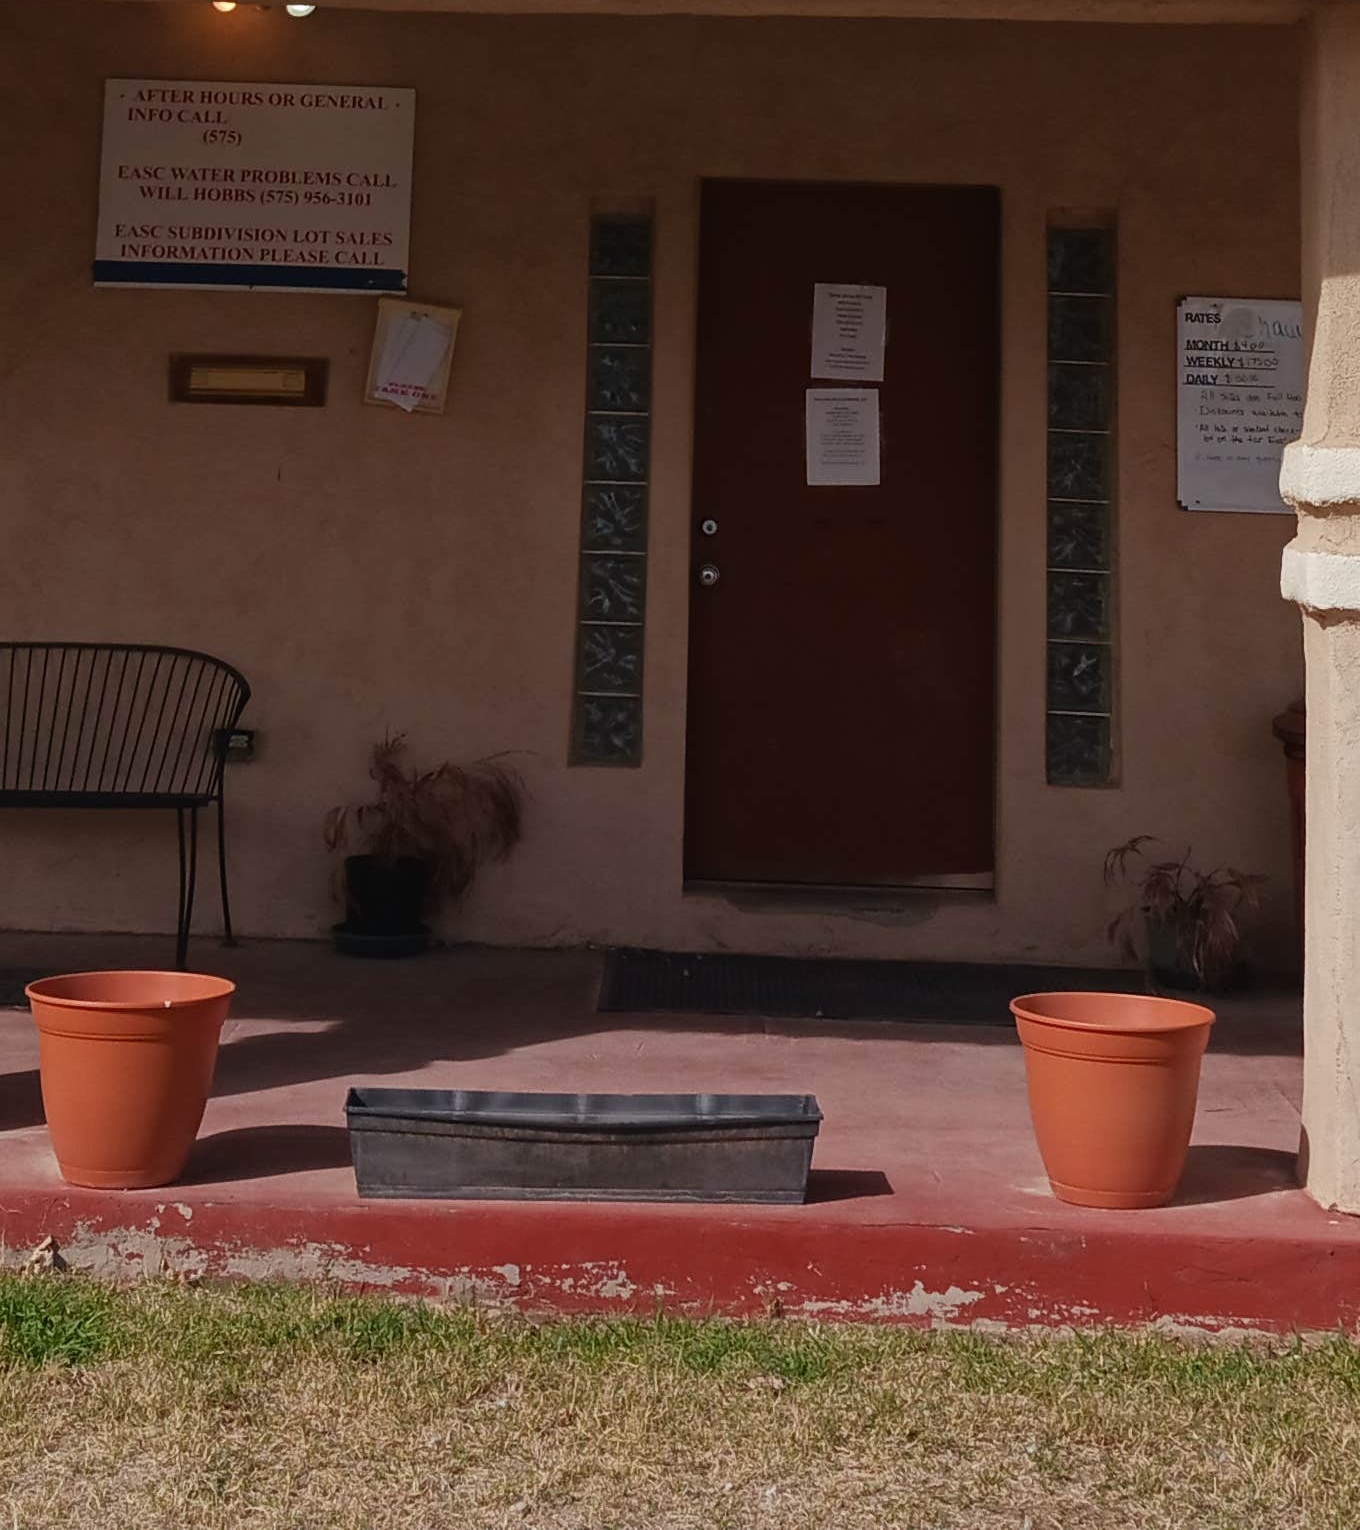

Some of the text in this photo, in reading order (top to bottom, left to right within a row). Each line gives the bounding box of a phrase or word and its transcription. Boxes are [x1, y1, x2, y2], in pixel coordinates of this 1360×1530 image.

[135, 89, 388, 110] AFTER HOURS OR GENERAL
[128, 108, 228, 124] INFO CALL
[202, 129, 243, 146] (575)
[118, 165, 397, 188] EASC WATER PROBLEMS CALL
[139, 185, 372, 207] WILL HOBBS (575) 956-3101
[115, 224, 393, 246] EASC SUBDIVISION LOT SALES
[120, 243, 384, 265] INFORMATION PLEASE CALL
[1185, 312, 1221, 324] RATES
[1186, 339, 1229, 351] MONTH
[1185, 356, 1235, 368] WEEKLY
[1186, 373, 1218, 386] DAILY
